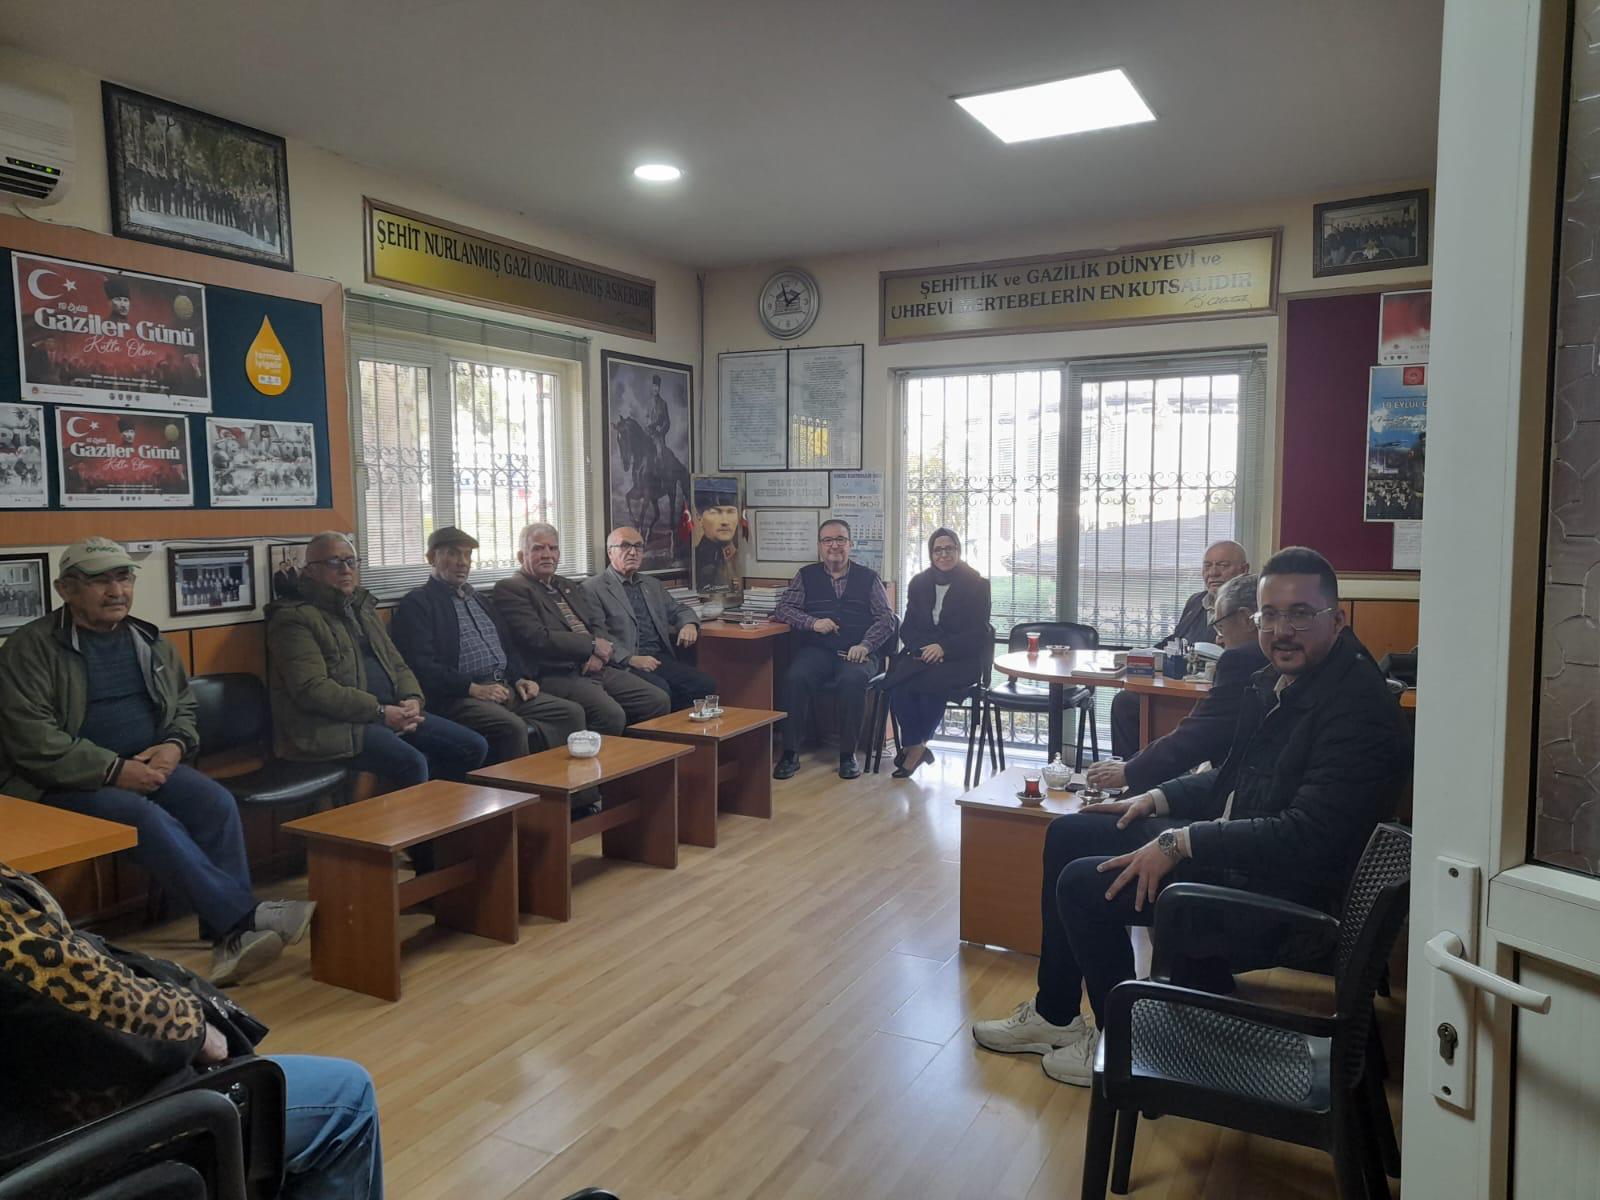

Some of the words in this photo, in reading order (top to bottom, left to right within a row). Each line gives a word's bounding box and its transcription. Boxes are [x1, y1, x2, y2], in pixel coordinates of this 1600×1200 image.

[377, 219, 421, 252] ŞEHİT
[424, 231, 501, 278] NURLANMIŞ
[504, 253, 531, 280] GAZİ
[534, 261, 603, 301] ONURLANMIŞ
[920, 271, 998, 300] ŞEHİTLİK
[1003, 274, 1021, 287] ve
[1026, 260, 1100, 285] GAZİLİK
[1106, 249, 1196, 277] DÜNYEVİ
[1201, 253, 1222, 266] ve
[891, 298, 954, 320] UHREVİ
[1100, 283, 1126, 301] EN
[1128, 272, 1253, 299] KUTSALIDIR
[34, 306, 131, 338] Gaziler
[136, 320, 195, 347] Günü
[70, 441, 134, 459] Gaziler
[138, 443, 180, 460] Günü
